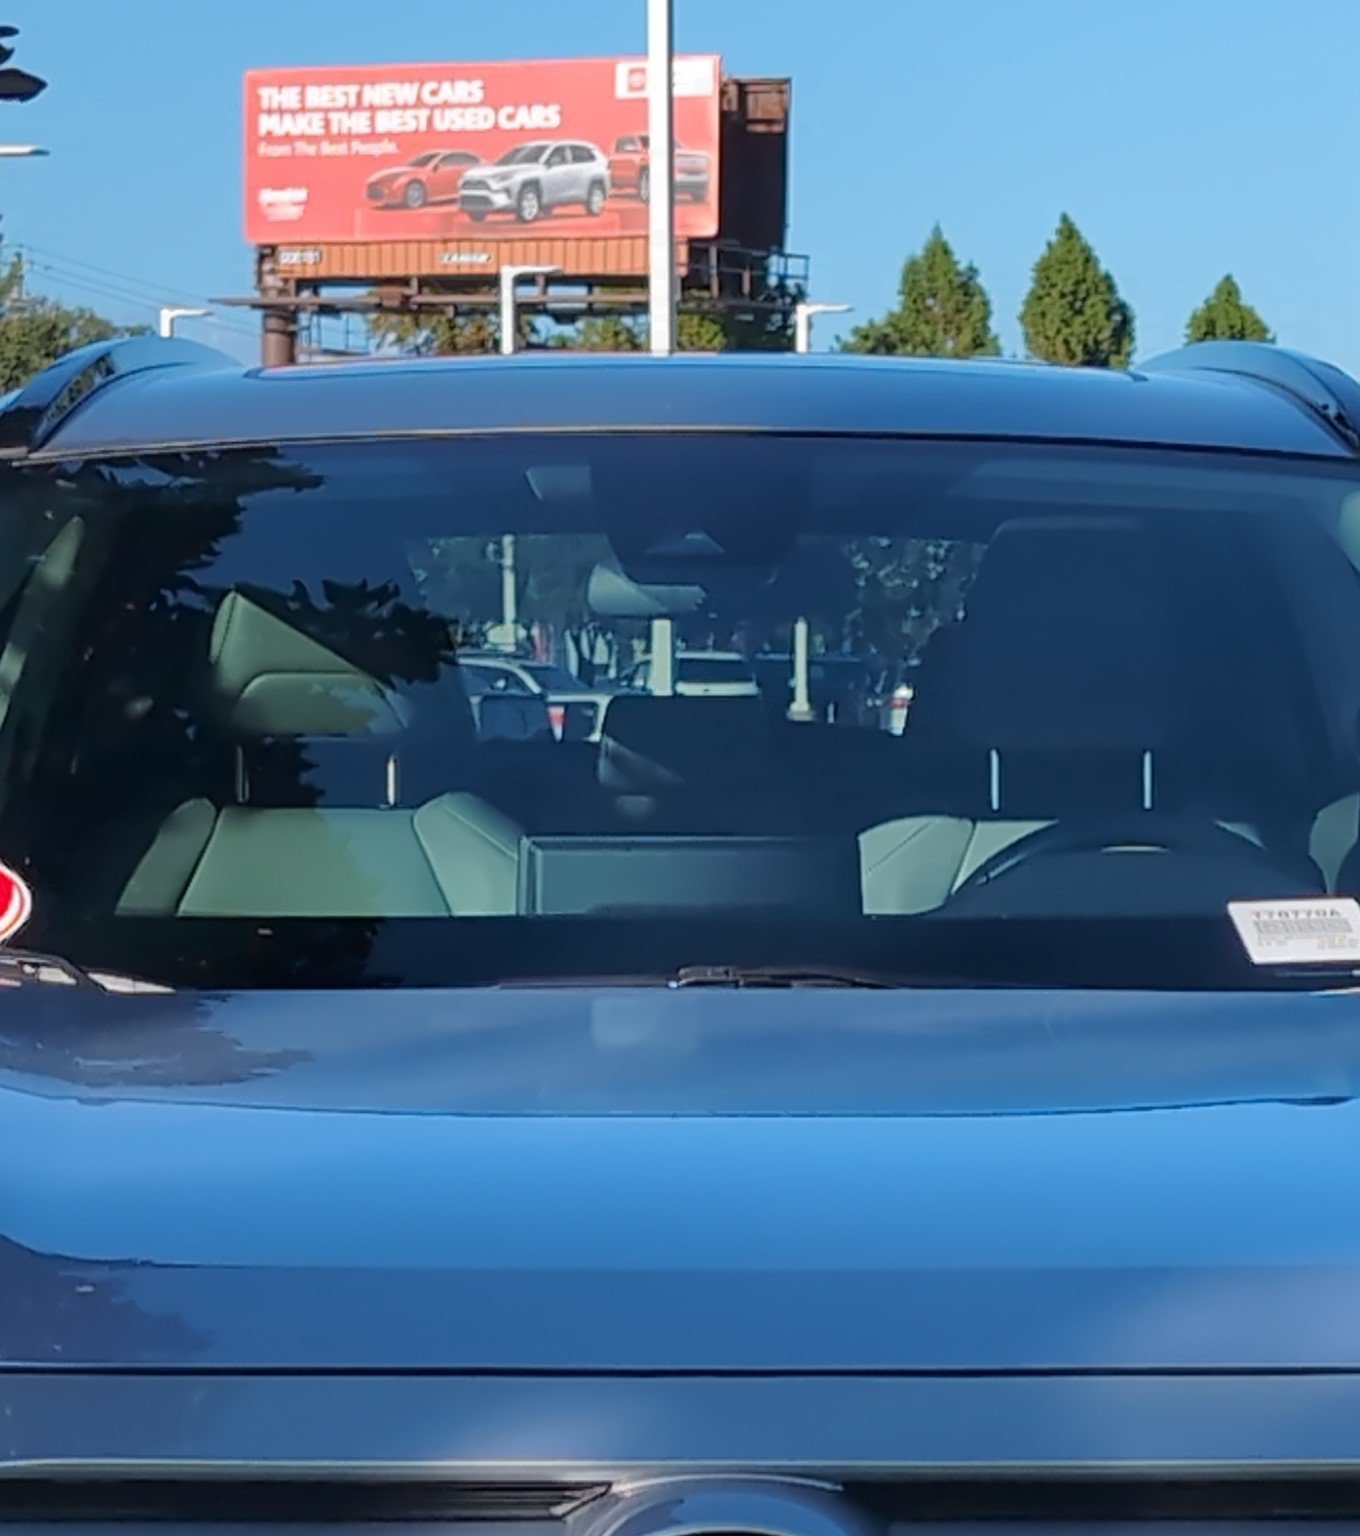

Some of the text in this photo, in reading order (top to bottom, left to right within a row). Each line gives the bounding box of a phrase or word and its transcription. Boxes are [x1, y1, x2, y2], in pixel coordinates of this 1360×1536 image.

[257, 79, 485, 110] THE BEST NEW CARS
[258, 104, 561, 137] MAKE THE BEST USED CARS
